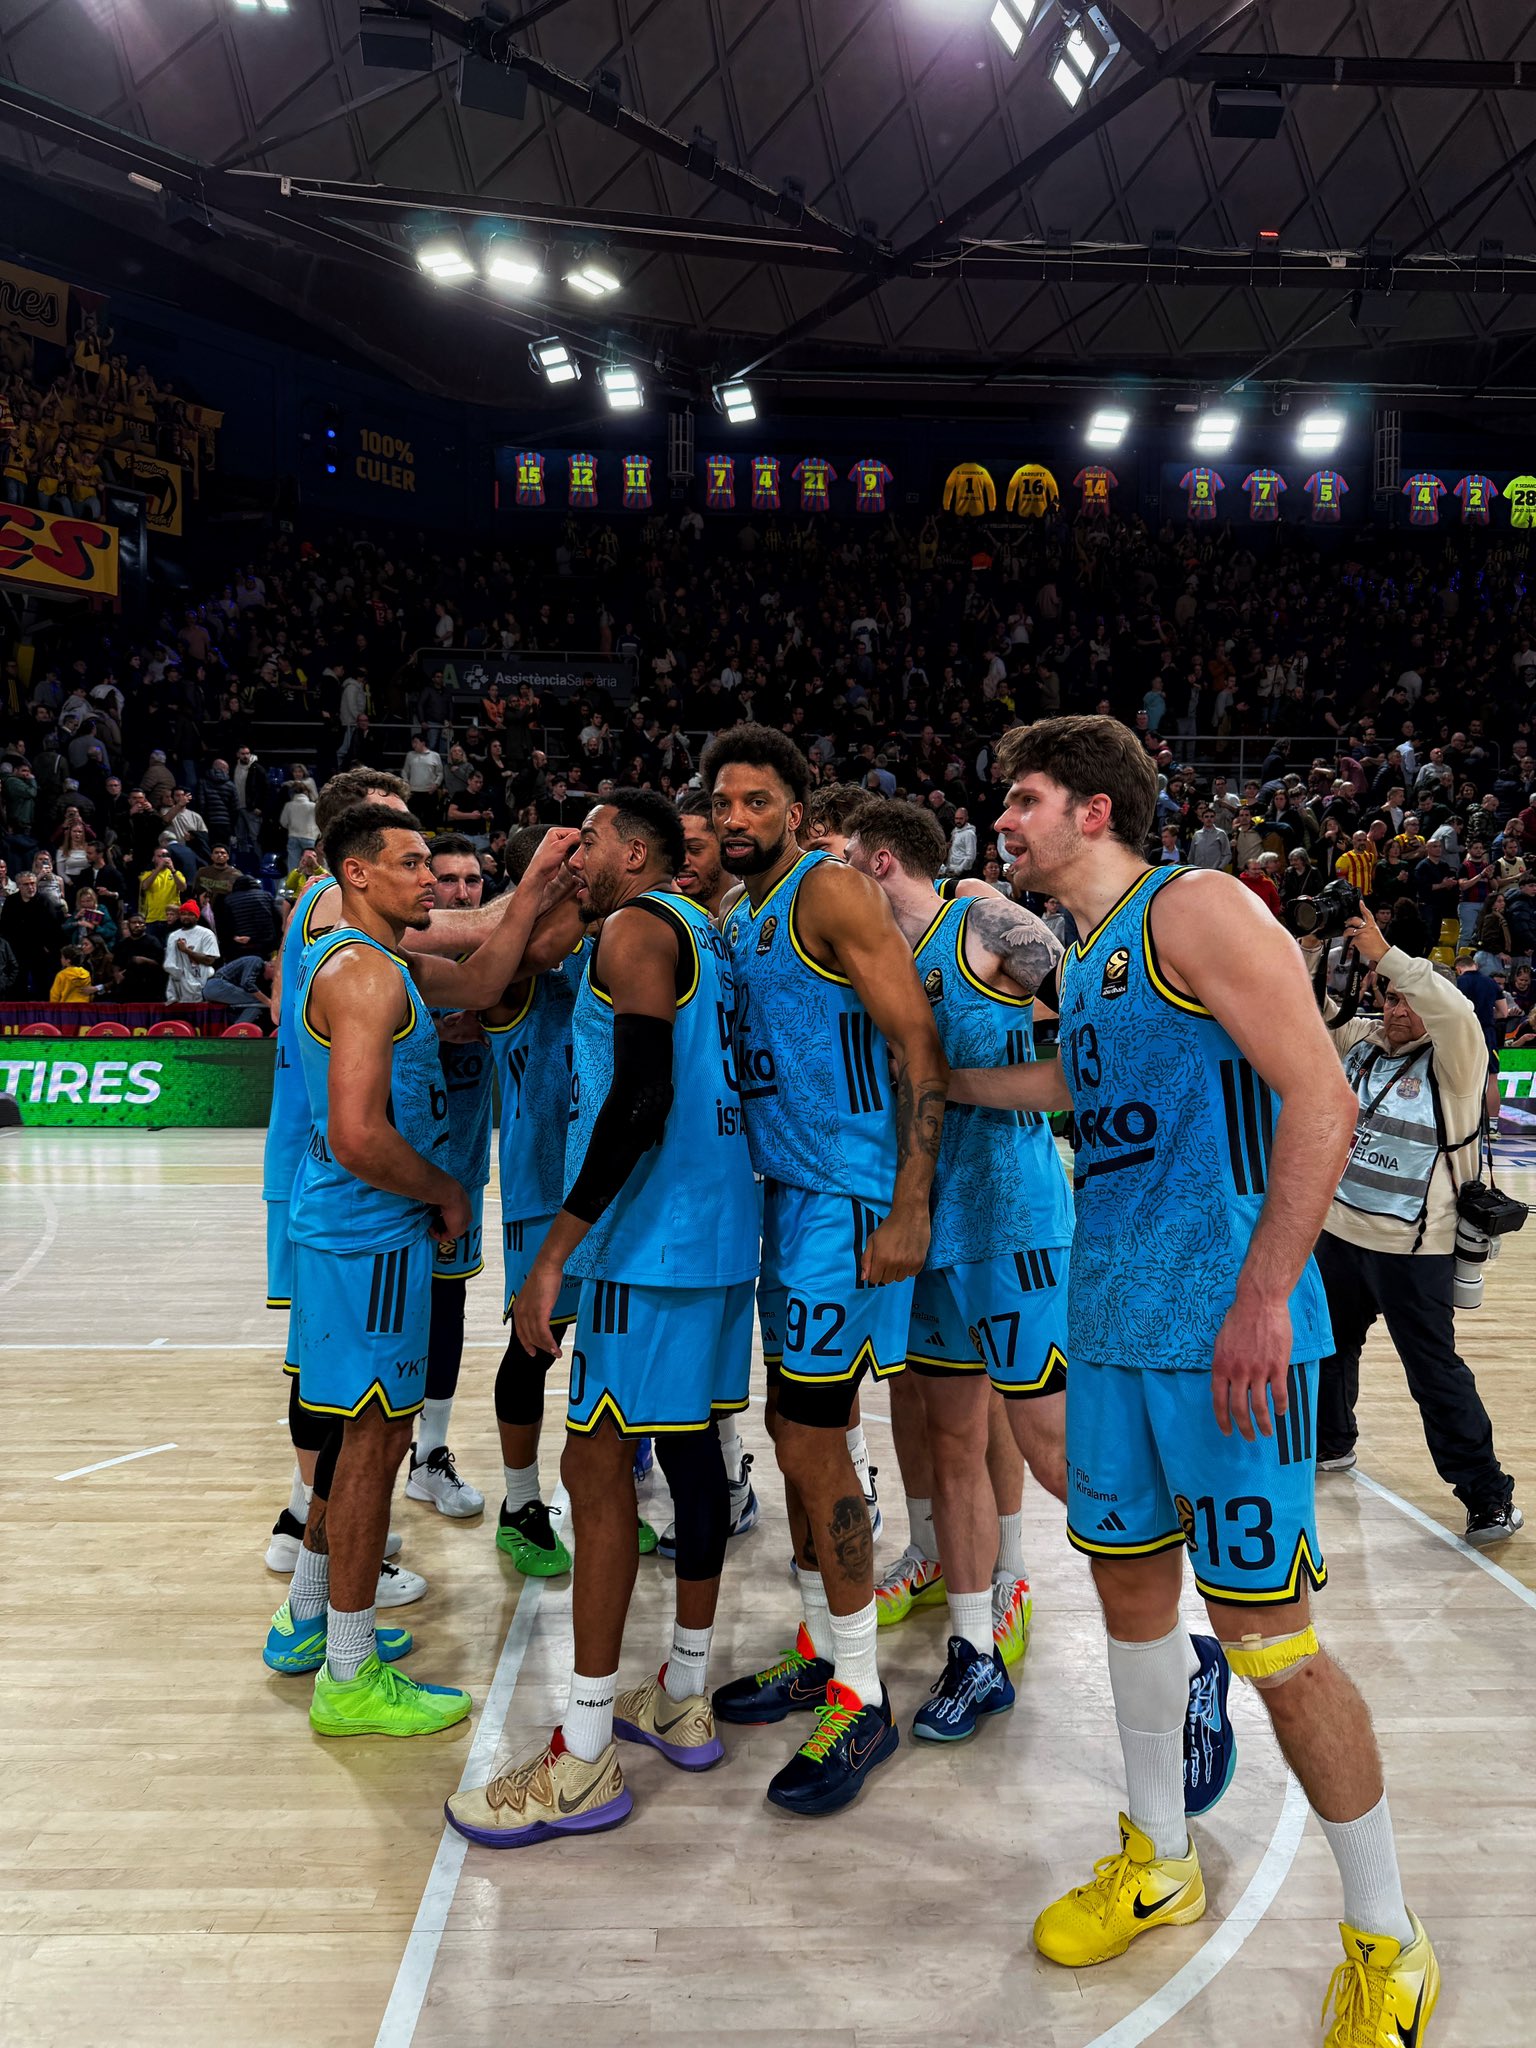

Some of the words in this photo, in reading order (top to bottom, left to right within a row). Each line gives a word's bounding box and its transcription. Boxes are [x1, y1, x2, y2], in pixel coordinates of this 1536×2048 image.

[359, 428, 414, 465] 100%
[354, 455, 416, 494] CULER
[518, 467, 541, 484] 15
[571, 468, 594, 485] 12
[626, 469, 647, 487] 11
[713, 470, 726, 487] 7
[758, 471, 773, 488] 4
[803, 472, 825, 490] 21
[863, 473, 877, 491] 9
[965, 477, 974, 494] 1
[1023, 478, 1044, 495] 16
[1084, 479, 1106, 497] 14
[1195, 481, 1209, 499] 8
[1259, 482, 1271, 500] 7
[1320, 484, 1334, 502] 5
[1417, 487, 1431, 504] 4
[1469, 488, 1482, 506] 2
[1514, 490, 1536, 506] 28
[1349, 970, 1360, 997] Canon
[1069, 1023, 1103, 1092] 13
[0, 1060, 163, 1105] TIRES
[785, 1297, 847, 1358] 92
[977, 1311, 1021, 1369] 17
[1076, 1467, 1091, 1484] Filo
[1076, 1480, 1119, 1503] Kiralama
[1196, 1495, 1277, 1571] 13
[672, 1643, 706, 1658] adidas
[576, 1695, 614, 1709] adidas
